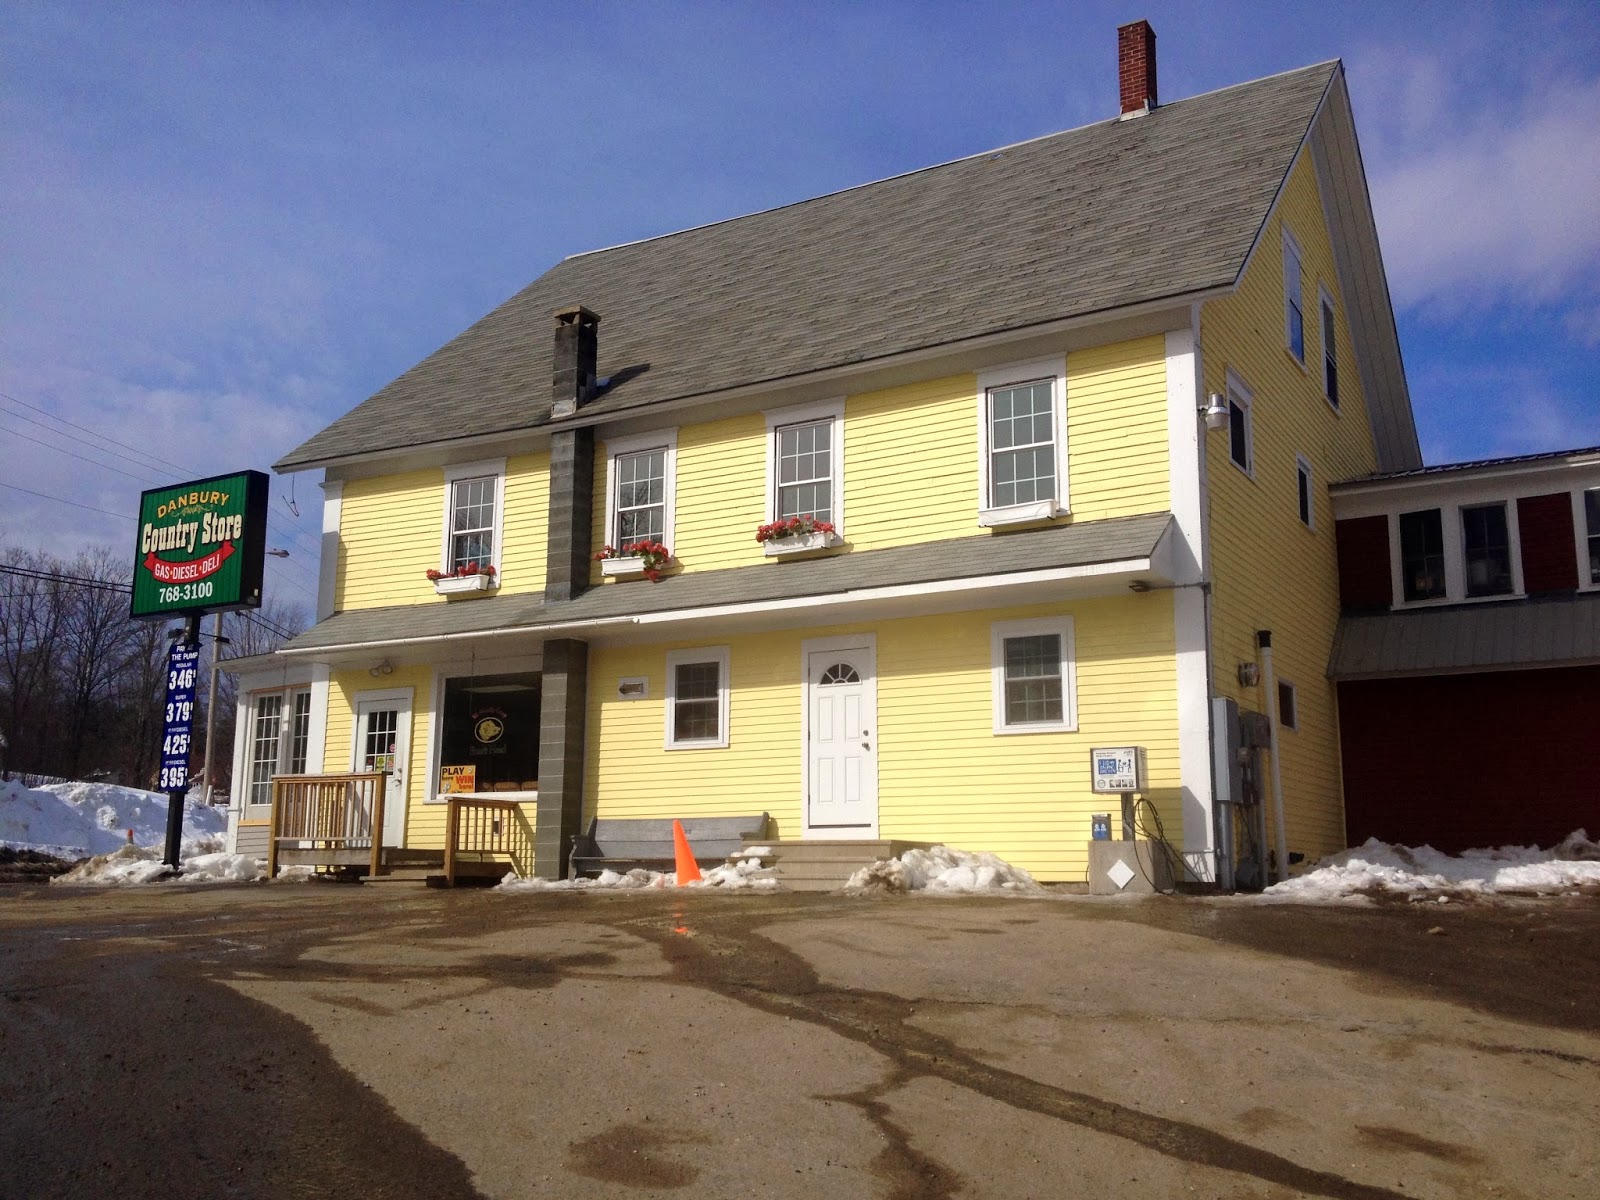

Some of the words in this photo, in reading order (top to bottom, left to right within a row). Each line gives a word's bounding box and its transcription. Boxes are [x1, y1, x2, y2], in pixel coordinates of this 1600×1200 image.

[157, 491, 230, 518] DANBURY
[141, 518, 199, 554] Country
[201, 511, 242, 544] Store
[155, 564, 170, 580] GAS
[172, 566, 199, 580] DIESEL
[202, 554, 220, 573] DELI
[159, 581, 213, 603] 768-3100
[183, 651, 199, 660] PUMP
[442, 767, 464, 776] PLAY
[456, 775, 474, 784] WIN
